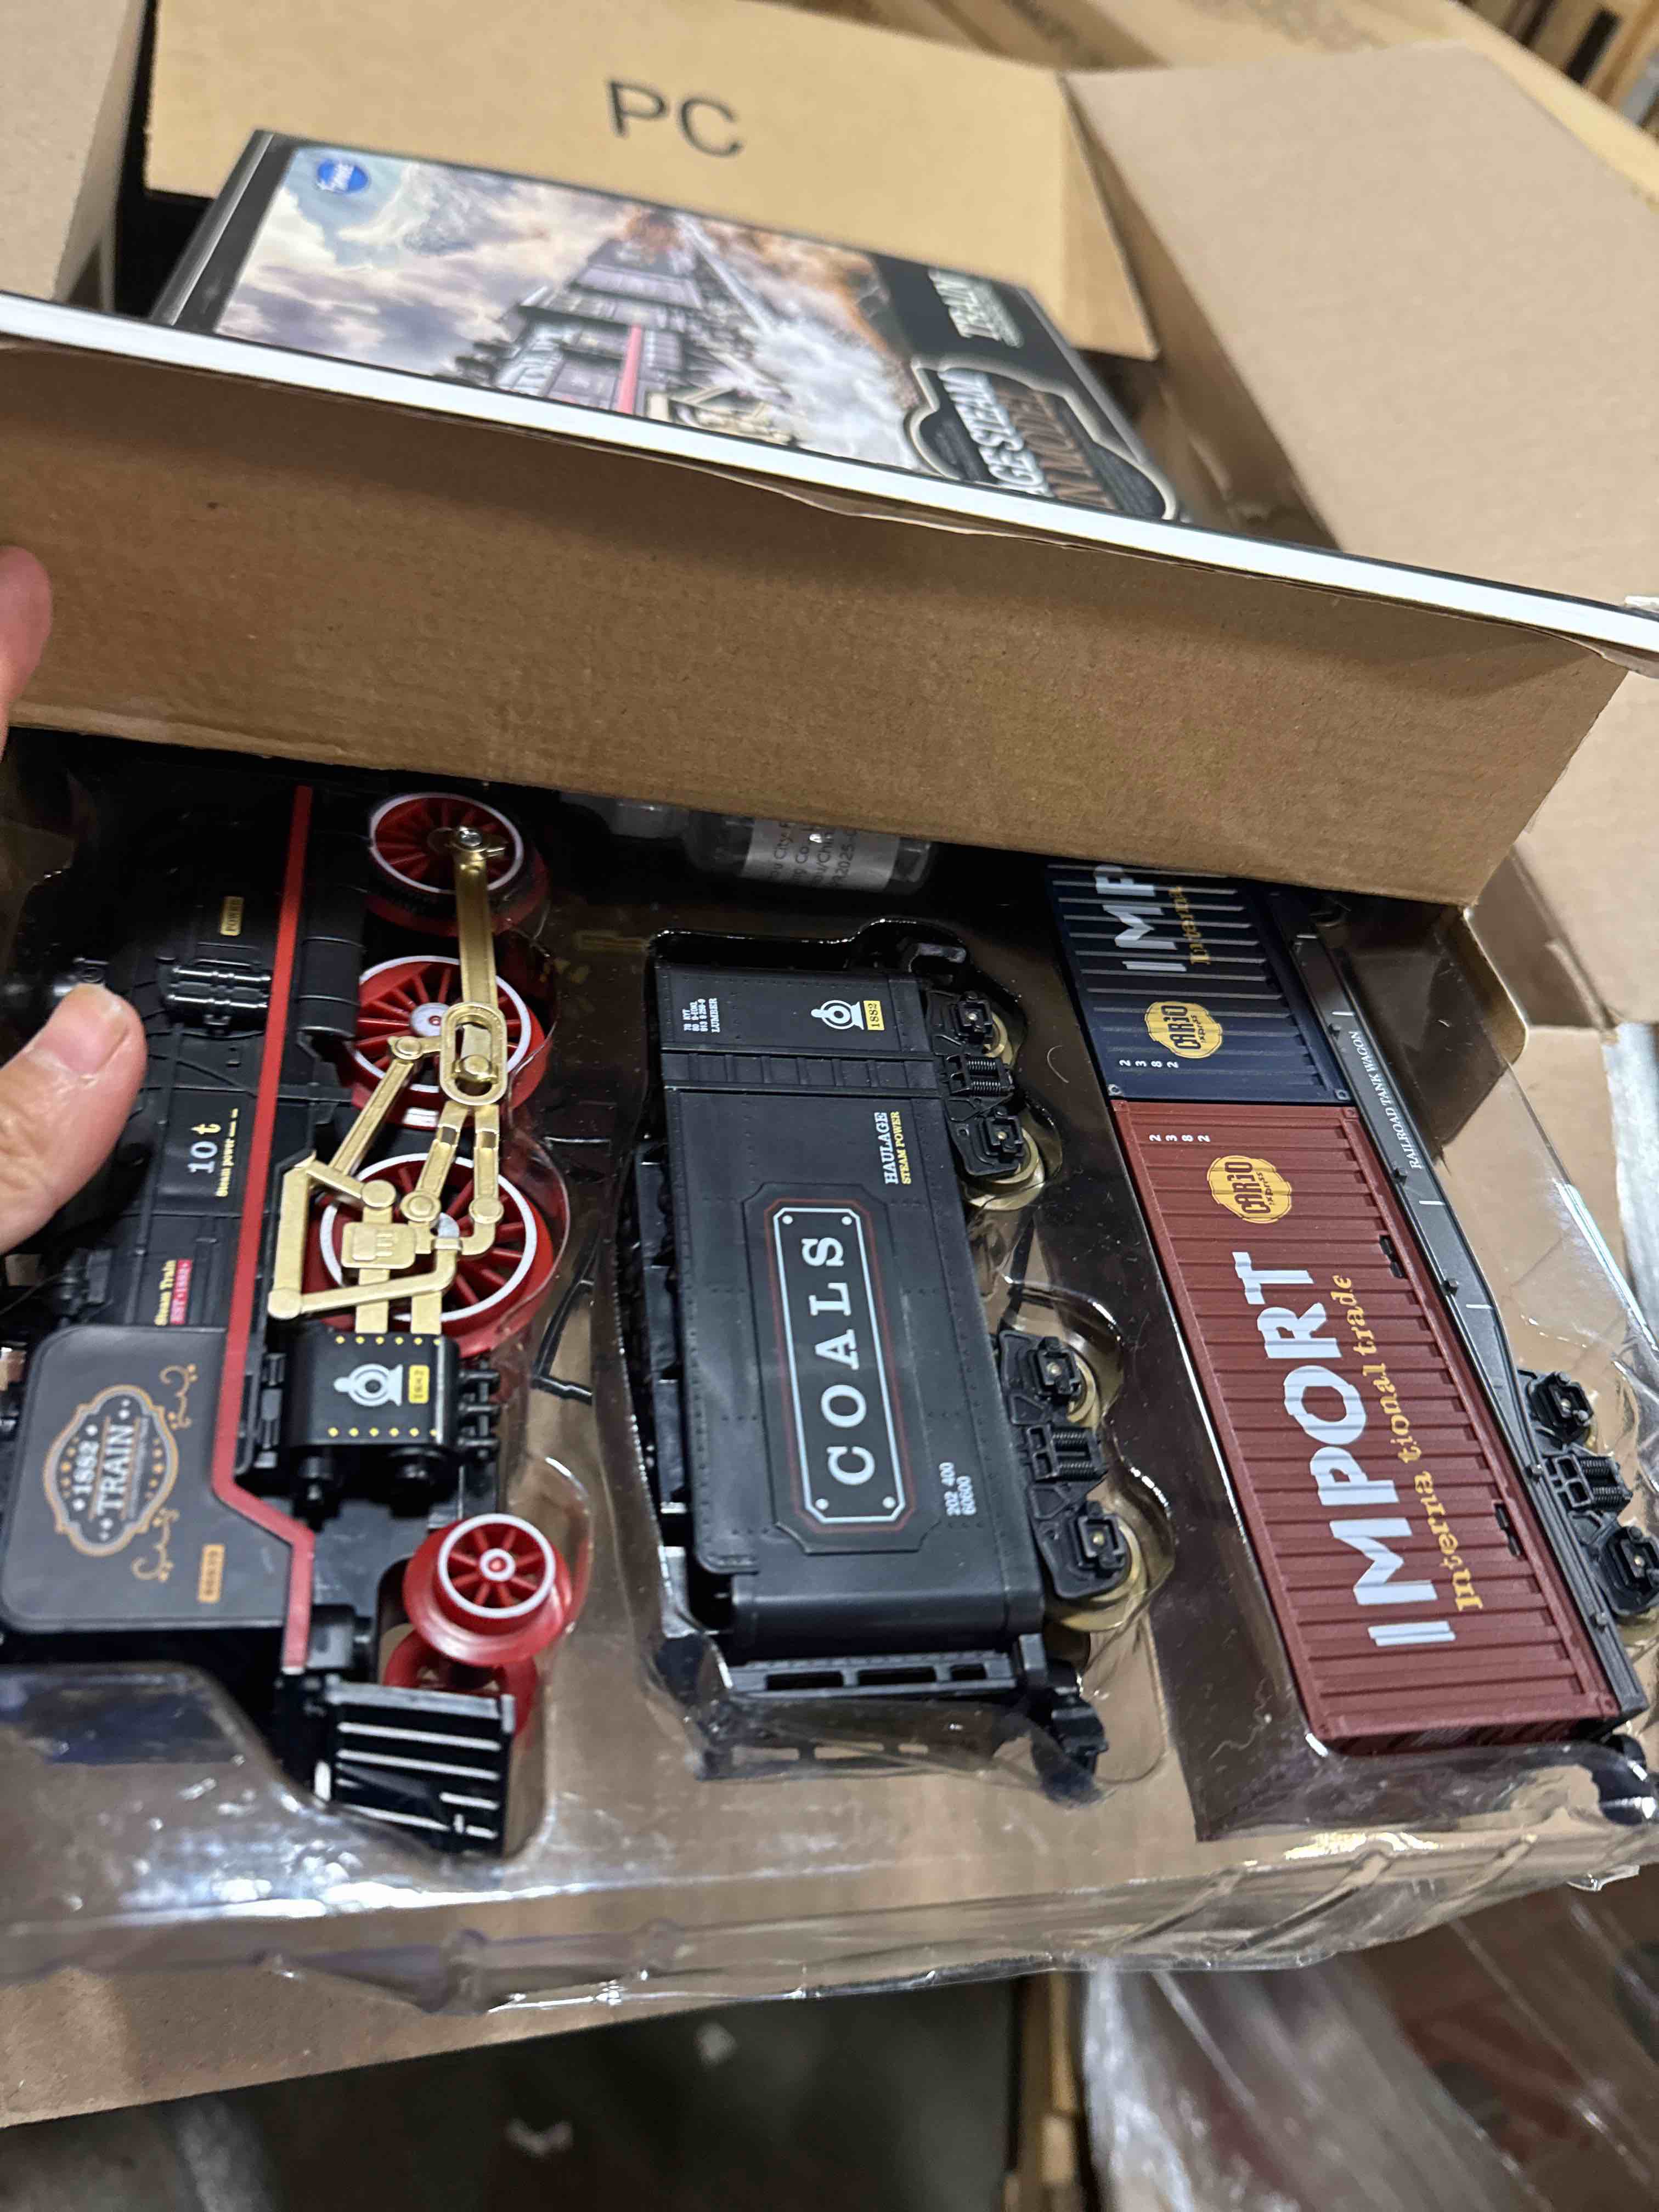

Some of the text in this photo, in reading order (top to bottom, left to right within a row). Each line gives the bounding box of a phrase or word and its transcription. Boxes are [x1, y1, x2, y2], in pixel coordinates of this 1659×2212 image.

[606, 77, 744, 159] PC
[708, 997, 721, 1032] LUMBER
[868, 1002, 881, 1028] 1882
[1348, 1030, 1422, 1170] RAILROAD TANK WAGON
[187, 1141, 218, 1173] 10
[874, 1111, 899, 1185] HAULAGE
[890, 1110, 912, 1185] STEAM POWER
[1331, 1274, 1379, 1357] trade
[801, 1237, 876, 1486] COALS
[72, 1441, 100, 1495] 1882
[95, 1425, 134, 1516] TRAIN
[1232, 1251, 1457, 1646] IMPORT
[939, 1462, 961, 1516] 202 400
